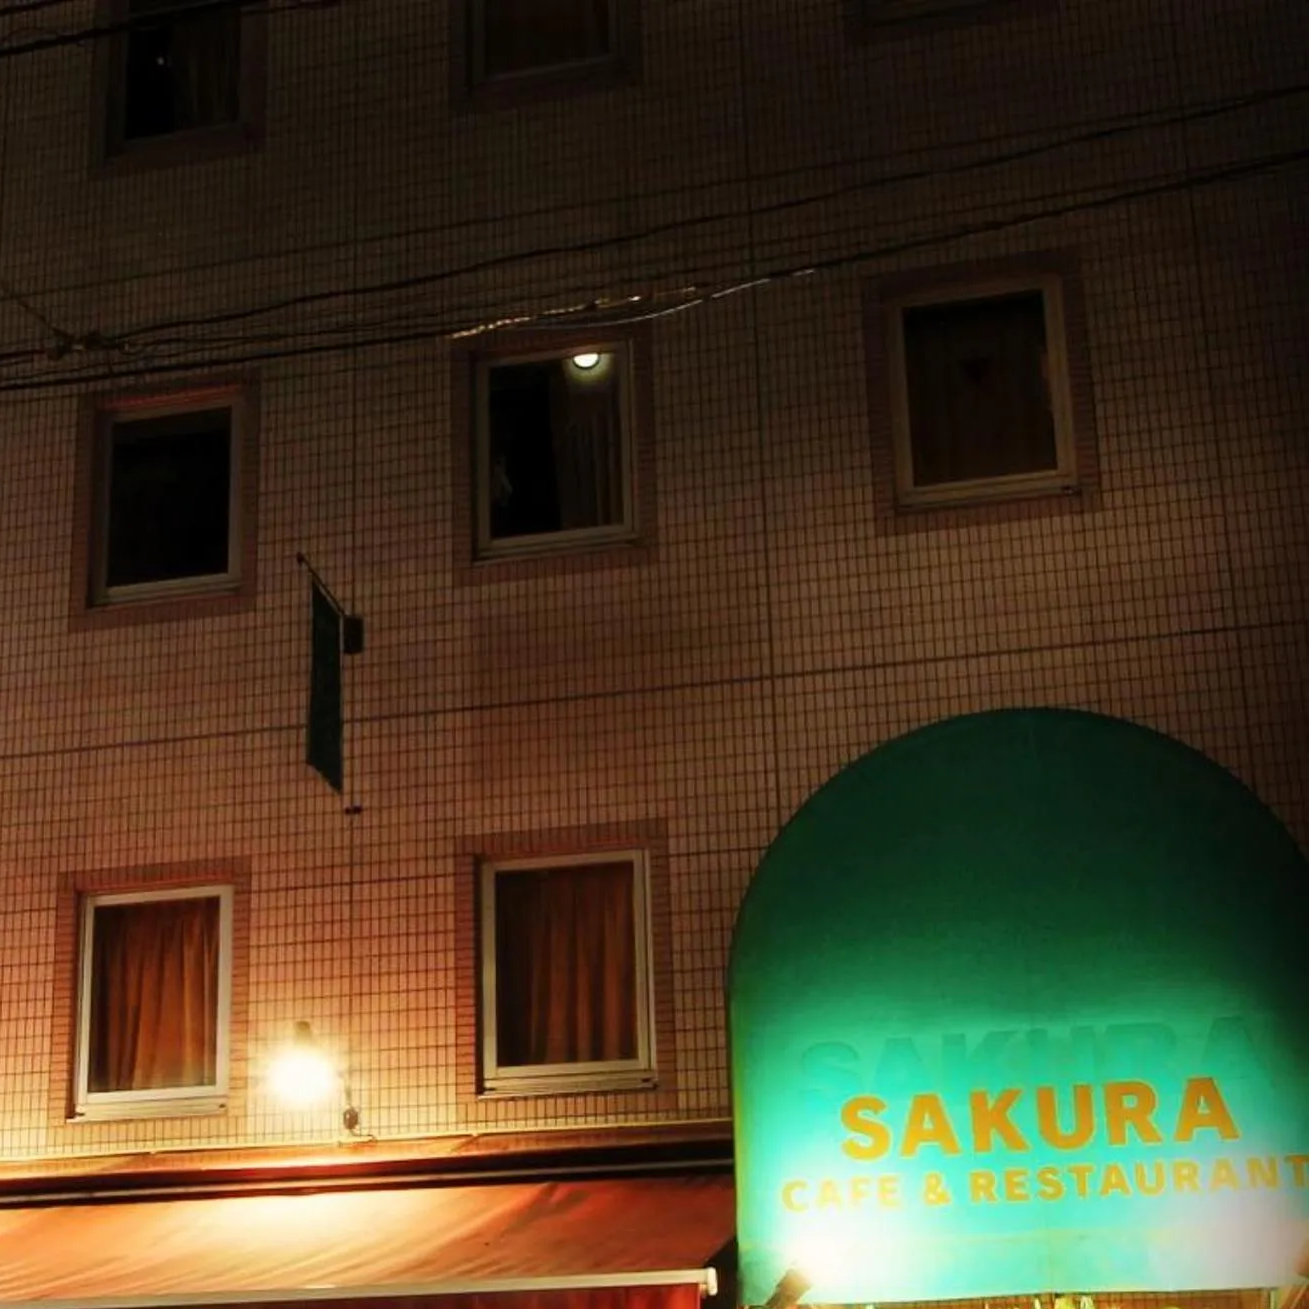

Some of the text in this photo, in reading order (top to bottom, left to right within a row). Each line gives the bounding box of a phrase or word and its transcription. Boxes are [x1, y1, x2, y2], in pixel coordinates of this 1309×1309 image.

[839, 1077, 1242, 1161] SAKURA
[781, 1153, 1309, 1213] CAFE & RESTAURANT
